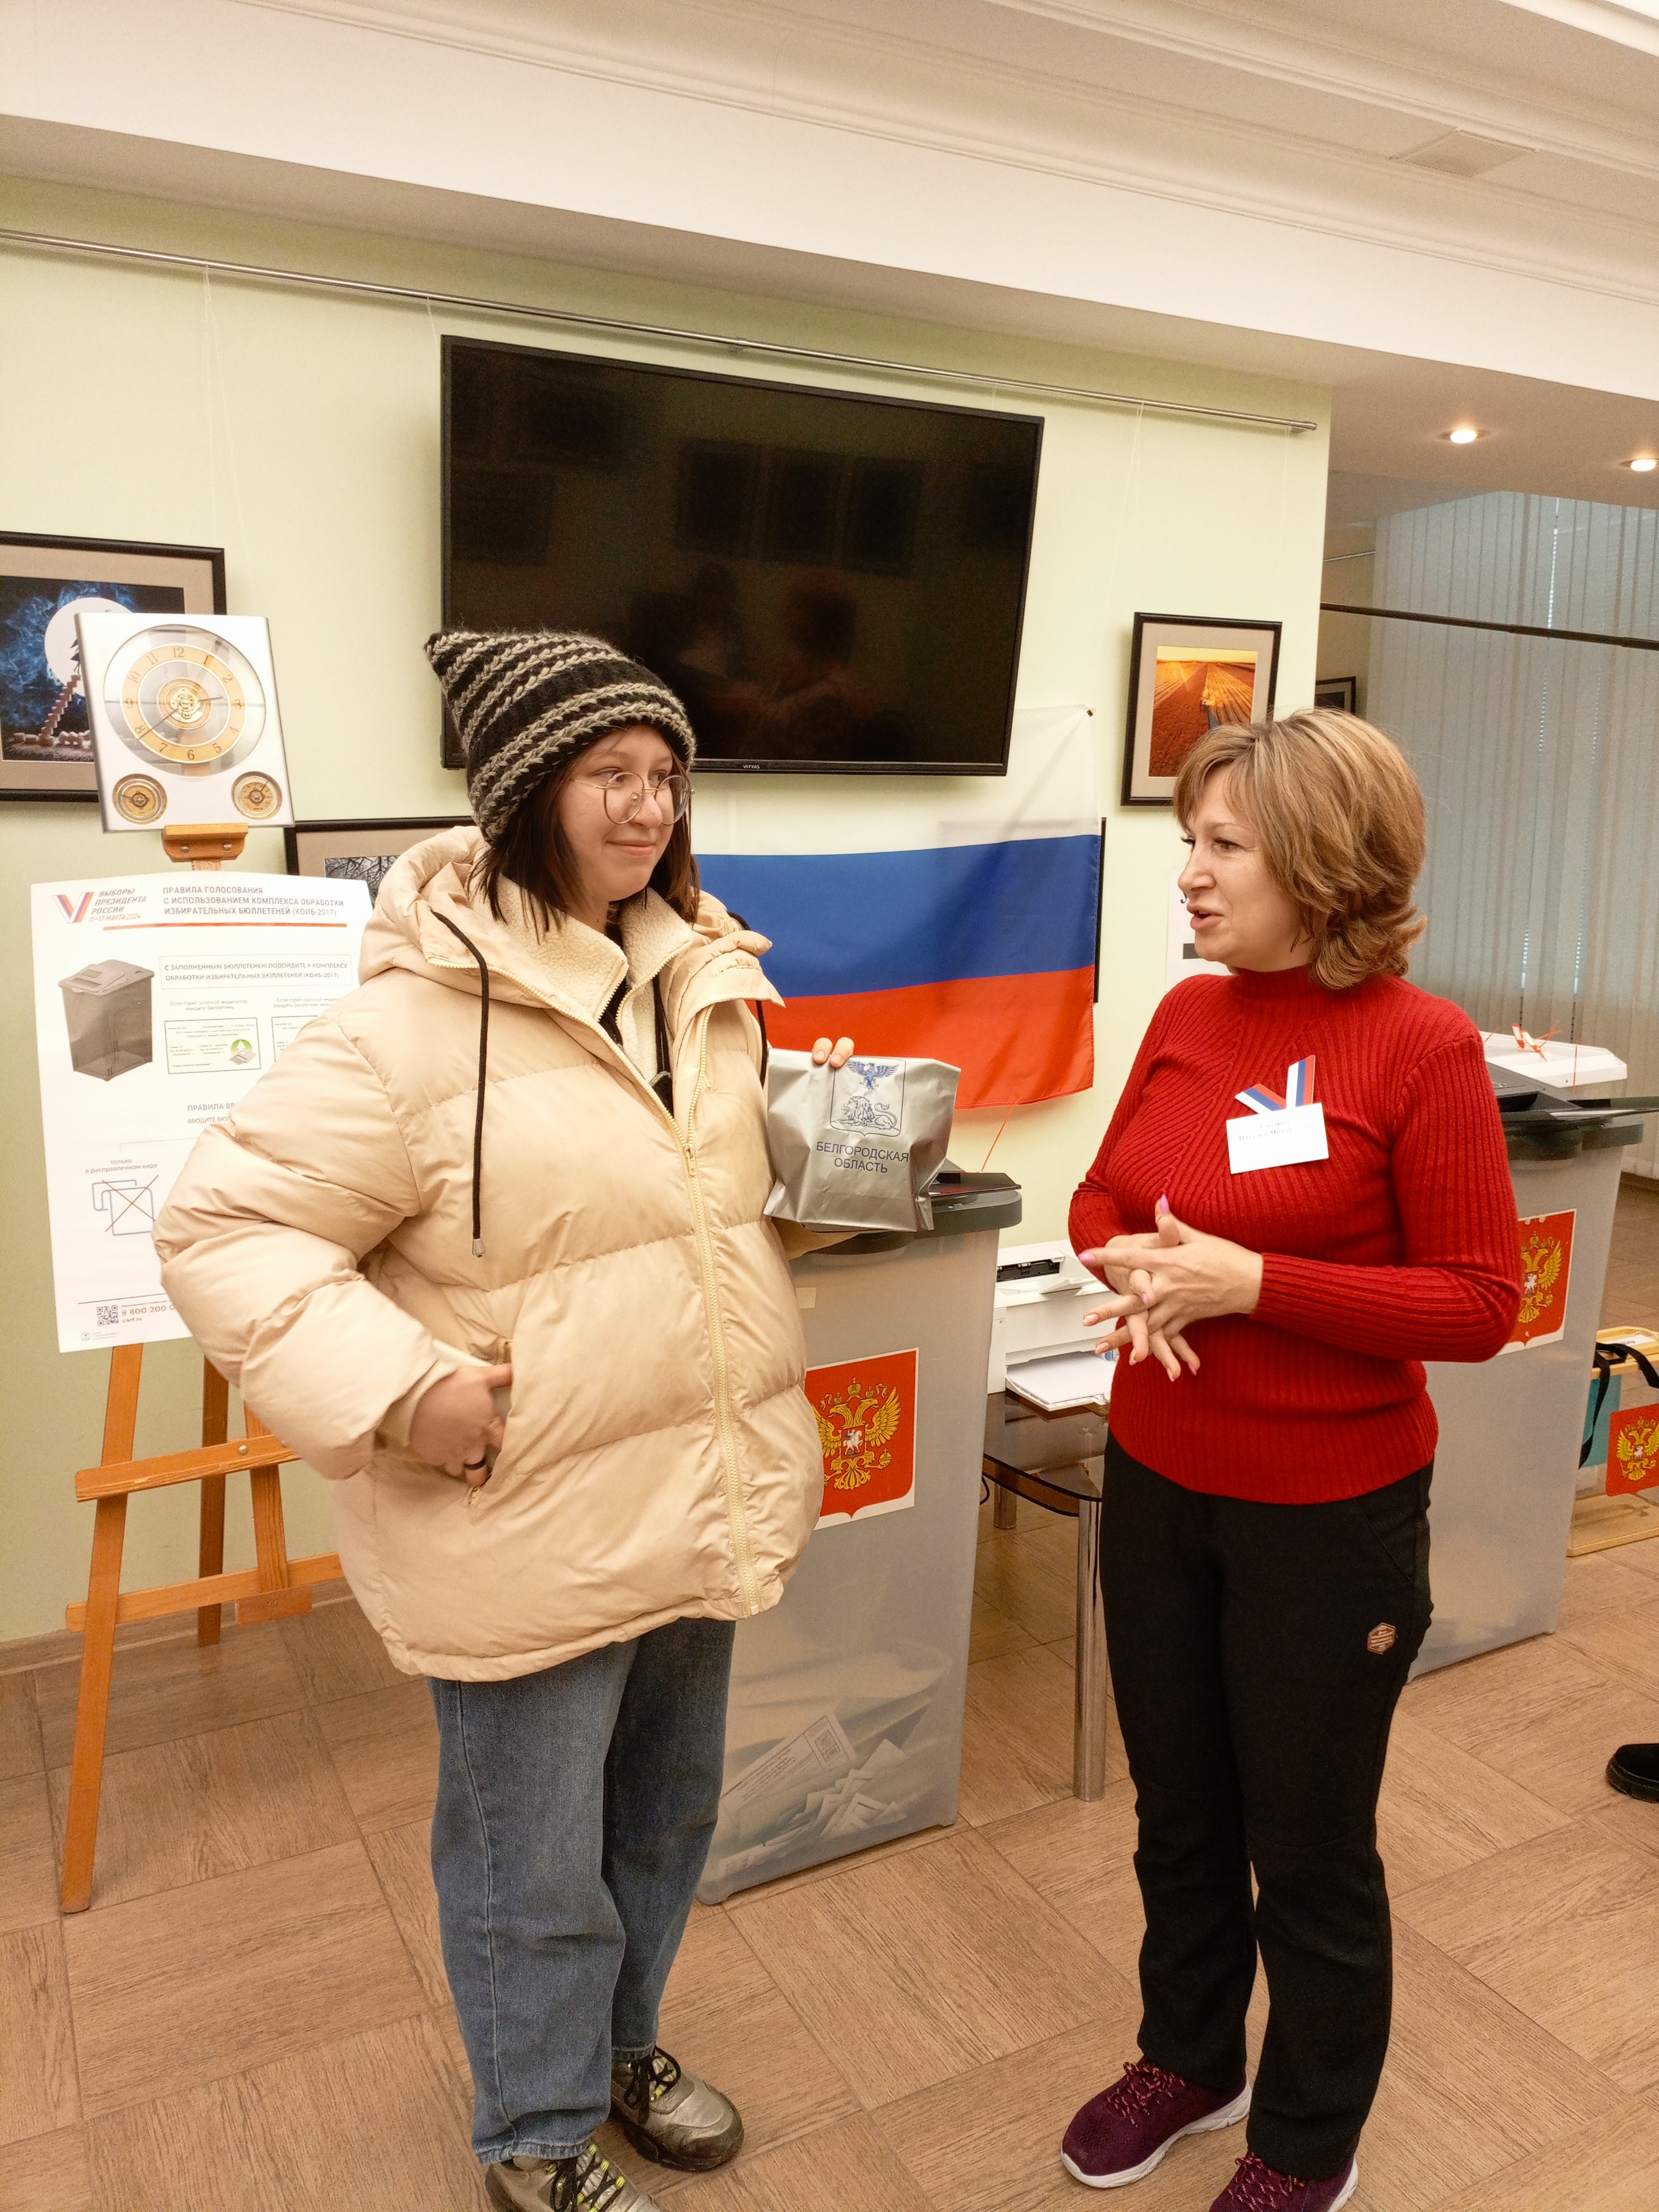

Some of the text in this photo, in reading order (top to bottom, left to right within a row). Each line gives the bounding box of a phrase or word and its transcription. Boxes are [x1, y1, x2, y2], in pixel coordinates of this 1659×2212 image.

[172, 647, 185, 658] 12
[146, 653, 159, 665] 11
[204, 655, 209, 665] 1
[128, 671, 141, 684] 10
[221, 674, 233, 684] 2
[126, 698, 133, 709] 9
[235, 699, 241, 709] 3
[134, 725, 145, 733] 8
[229, 726, 240, 734] 4
[159, 743, 168, 752] 7
[212, 743, 221, 753] 5
[187, 750, 194, 760] 6
[98, 888, 135, 897] ВЫБОРЫ
[95, 896, 146, 906] ПРЕЗИДЕНТА
[91, 906, 124, 914] РОССИИ
[293, 908, 337, 916] (КОИБ-2017)
[816, 1141, 909, 1163] БЕЛГОРОДСКАЯ
[91, 1165, 141, 1174] расправленном
[834, 1157, 888, 1173] ОБЛАСТЬ
